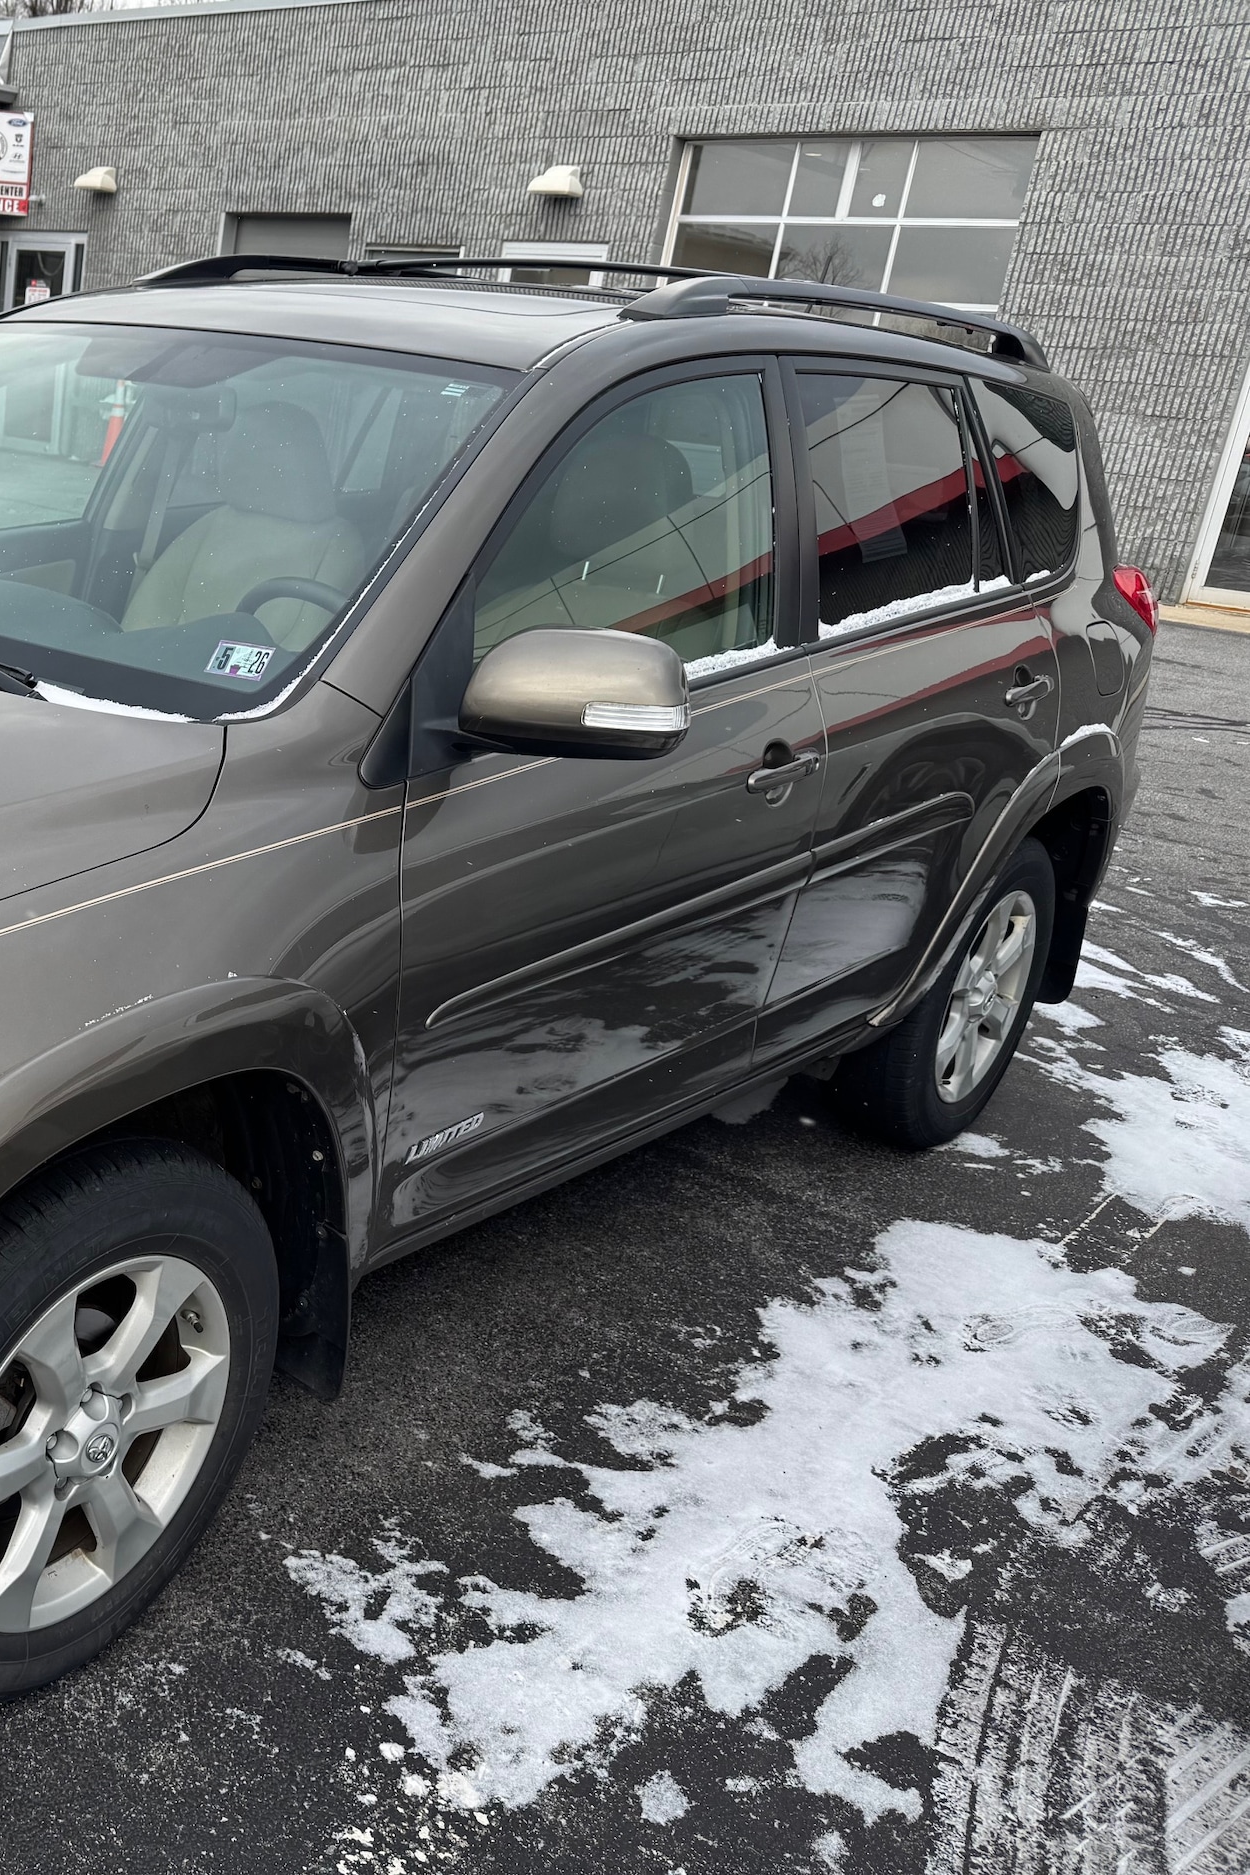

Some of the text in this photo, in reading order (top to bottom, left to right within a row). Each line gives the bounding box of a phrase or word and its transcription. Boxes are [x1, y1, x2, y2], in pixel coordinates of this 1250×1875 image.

[217, 647, 234, 670] 5
[248, 651, 270, 674] 26
[404, 1111, 485, 1165] LIMITED
